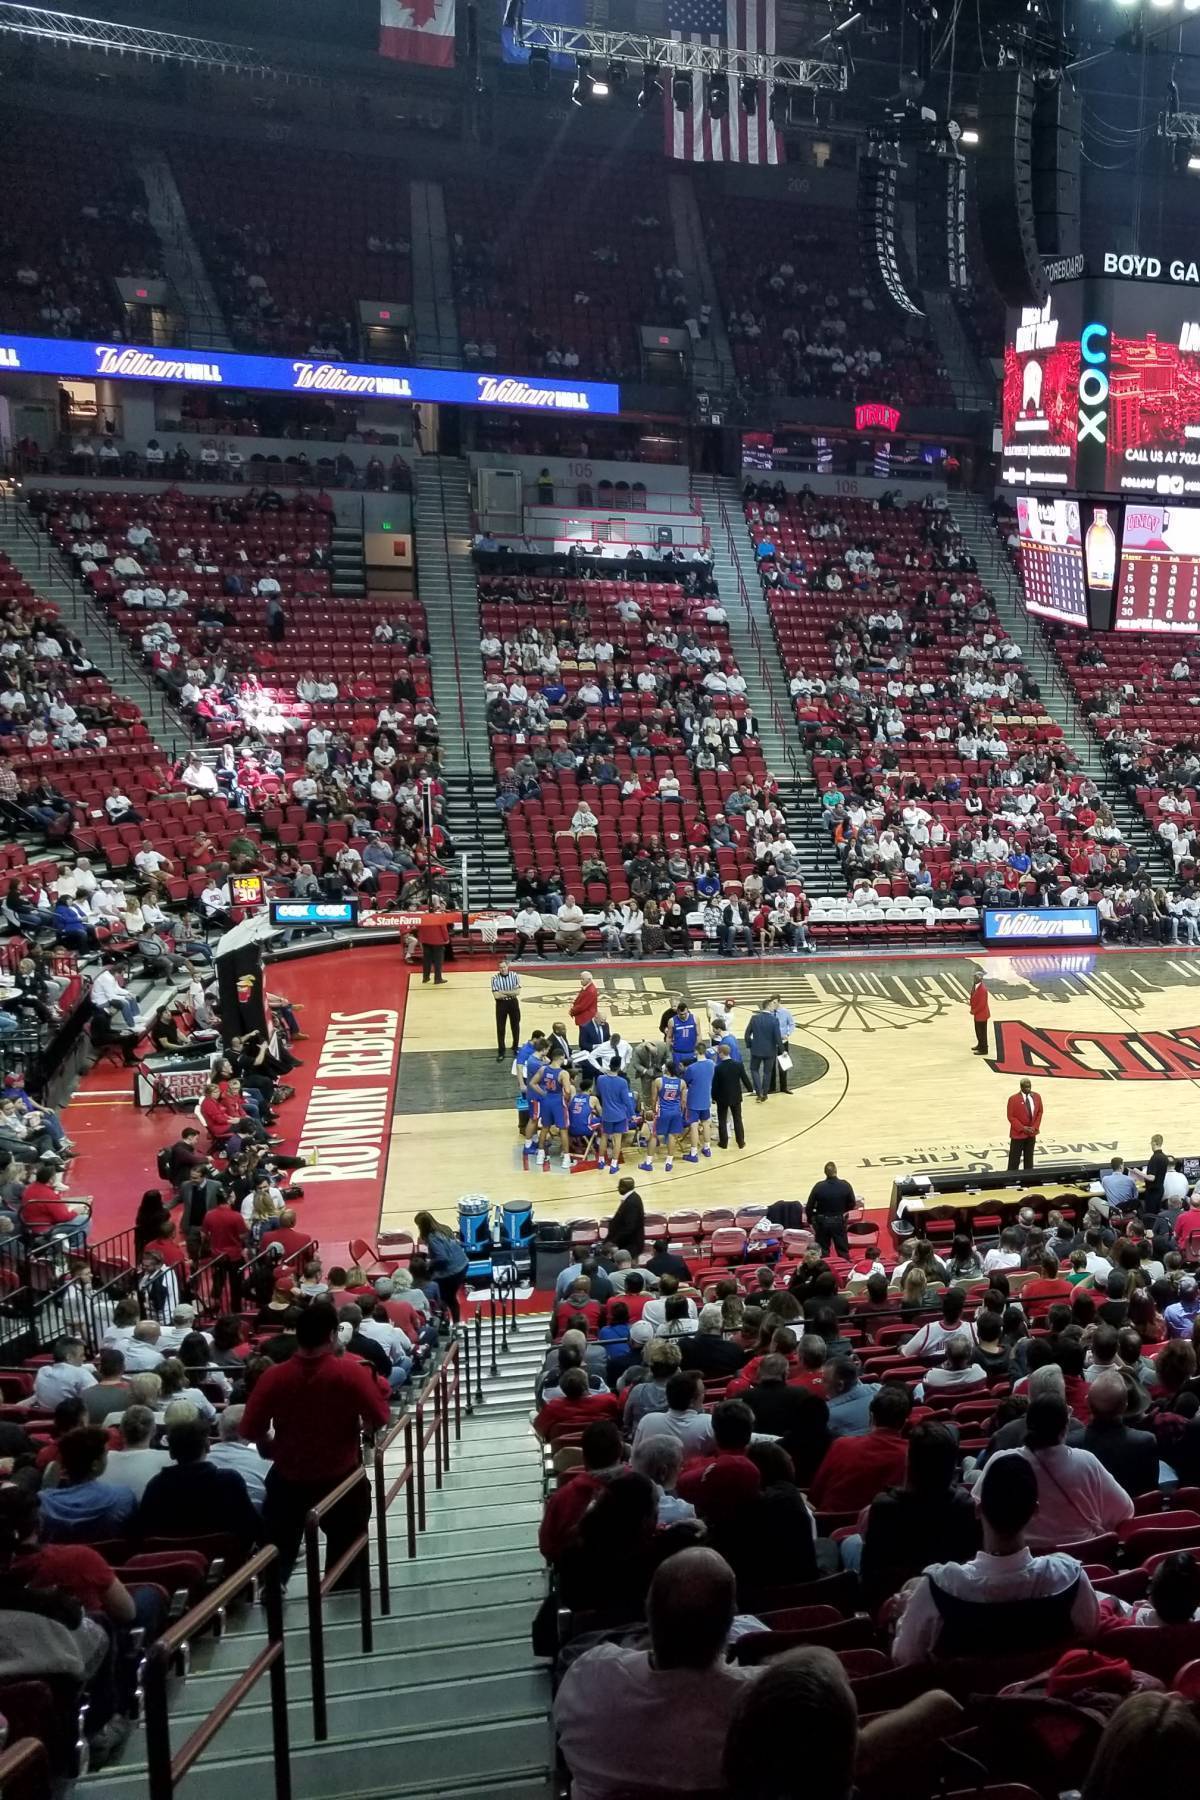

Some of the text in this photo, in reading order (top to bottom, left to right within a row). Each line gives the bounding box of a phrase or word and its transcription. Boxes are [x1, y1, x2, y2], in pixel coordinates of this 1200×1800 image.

[1104, 253, 1162, 277] BOYD
[1077, 323, 1109, 443] COX
[855, 404, 901, 432] UNLV
[1125, 449, 1149, 462] CALL
[1151, 451, 1163, 463] US
[1165, 452, 1178, 464] AT
[568, 462, 592, 478] 105
[834, 479, 858, 495] 106
[1128, 563, 1134, 571] 3
[1152, 564, 1158, 573] 3
[1171, 565, 1177, 573] 3
[1194, 566, 1198, 575] 1
[1127, 574, 1133, 582] 5
[1150, 575, 1157, 584] 0
[1169, 576, 1176, 585] 0
[1192, 577, 1197, 586] 1
[1124, 585, 1135, 593] 13
[1149, 586, 1156, 595] 0
[1168, 587, 1175, 596] 0
[1190, 588, 1197, 597] 0
[1122, 597, 1134, 605] 24
[1149, 598, 1155, 607] 3
[1167, 599, 1174, 607] 2
[1189, 600, 1196, 608] 0
[1121, 608, 1133, 616] 30
[1148, 609, 1153, 618] 1
[1166, 610, 1173, 618] 0
[1188, 611, 1195, 619] 0
[239, 889, 257, 902] 30
[376, 916, 422, 926] StateFarm
[289, 1009, 399, 1185] RUNNIN' REBELS
[857, 1152, 958, 1169] FIRST
